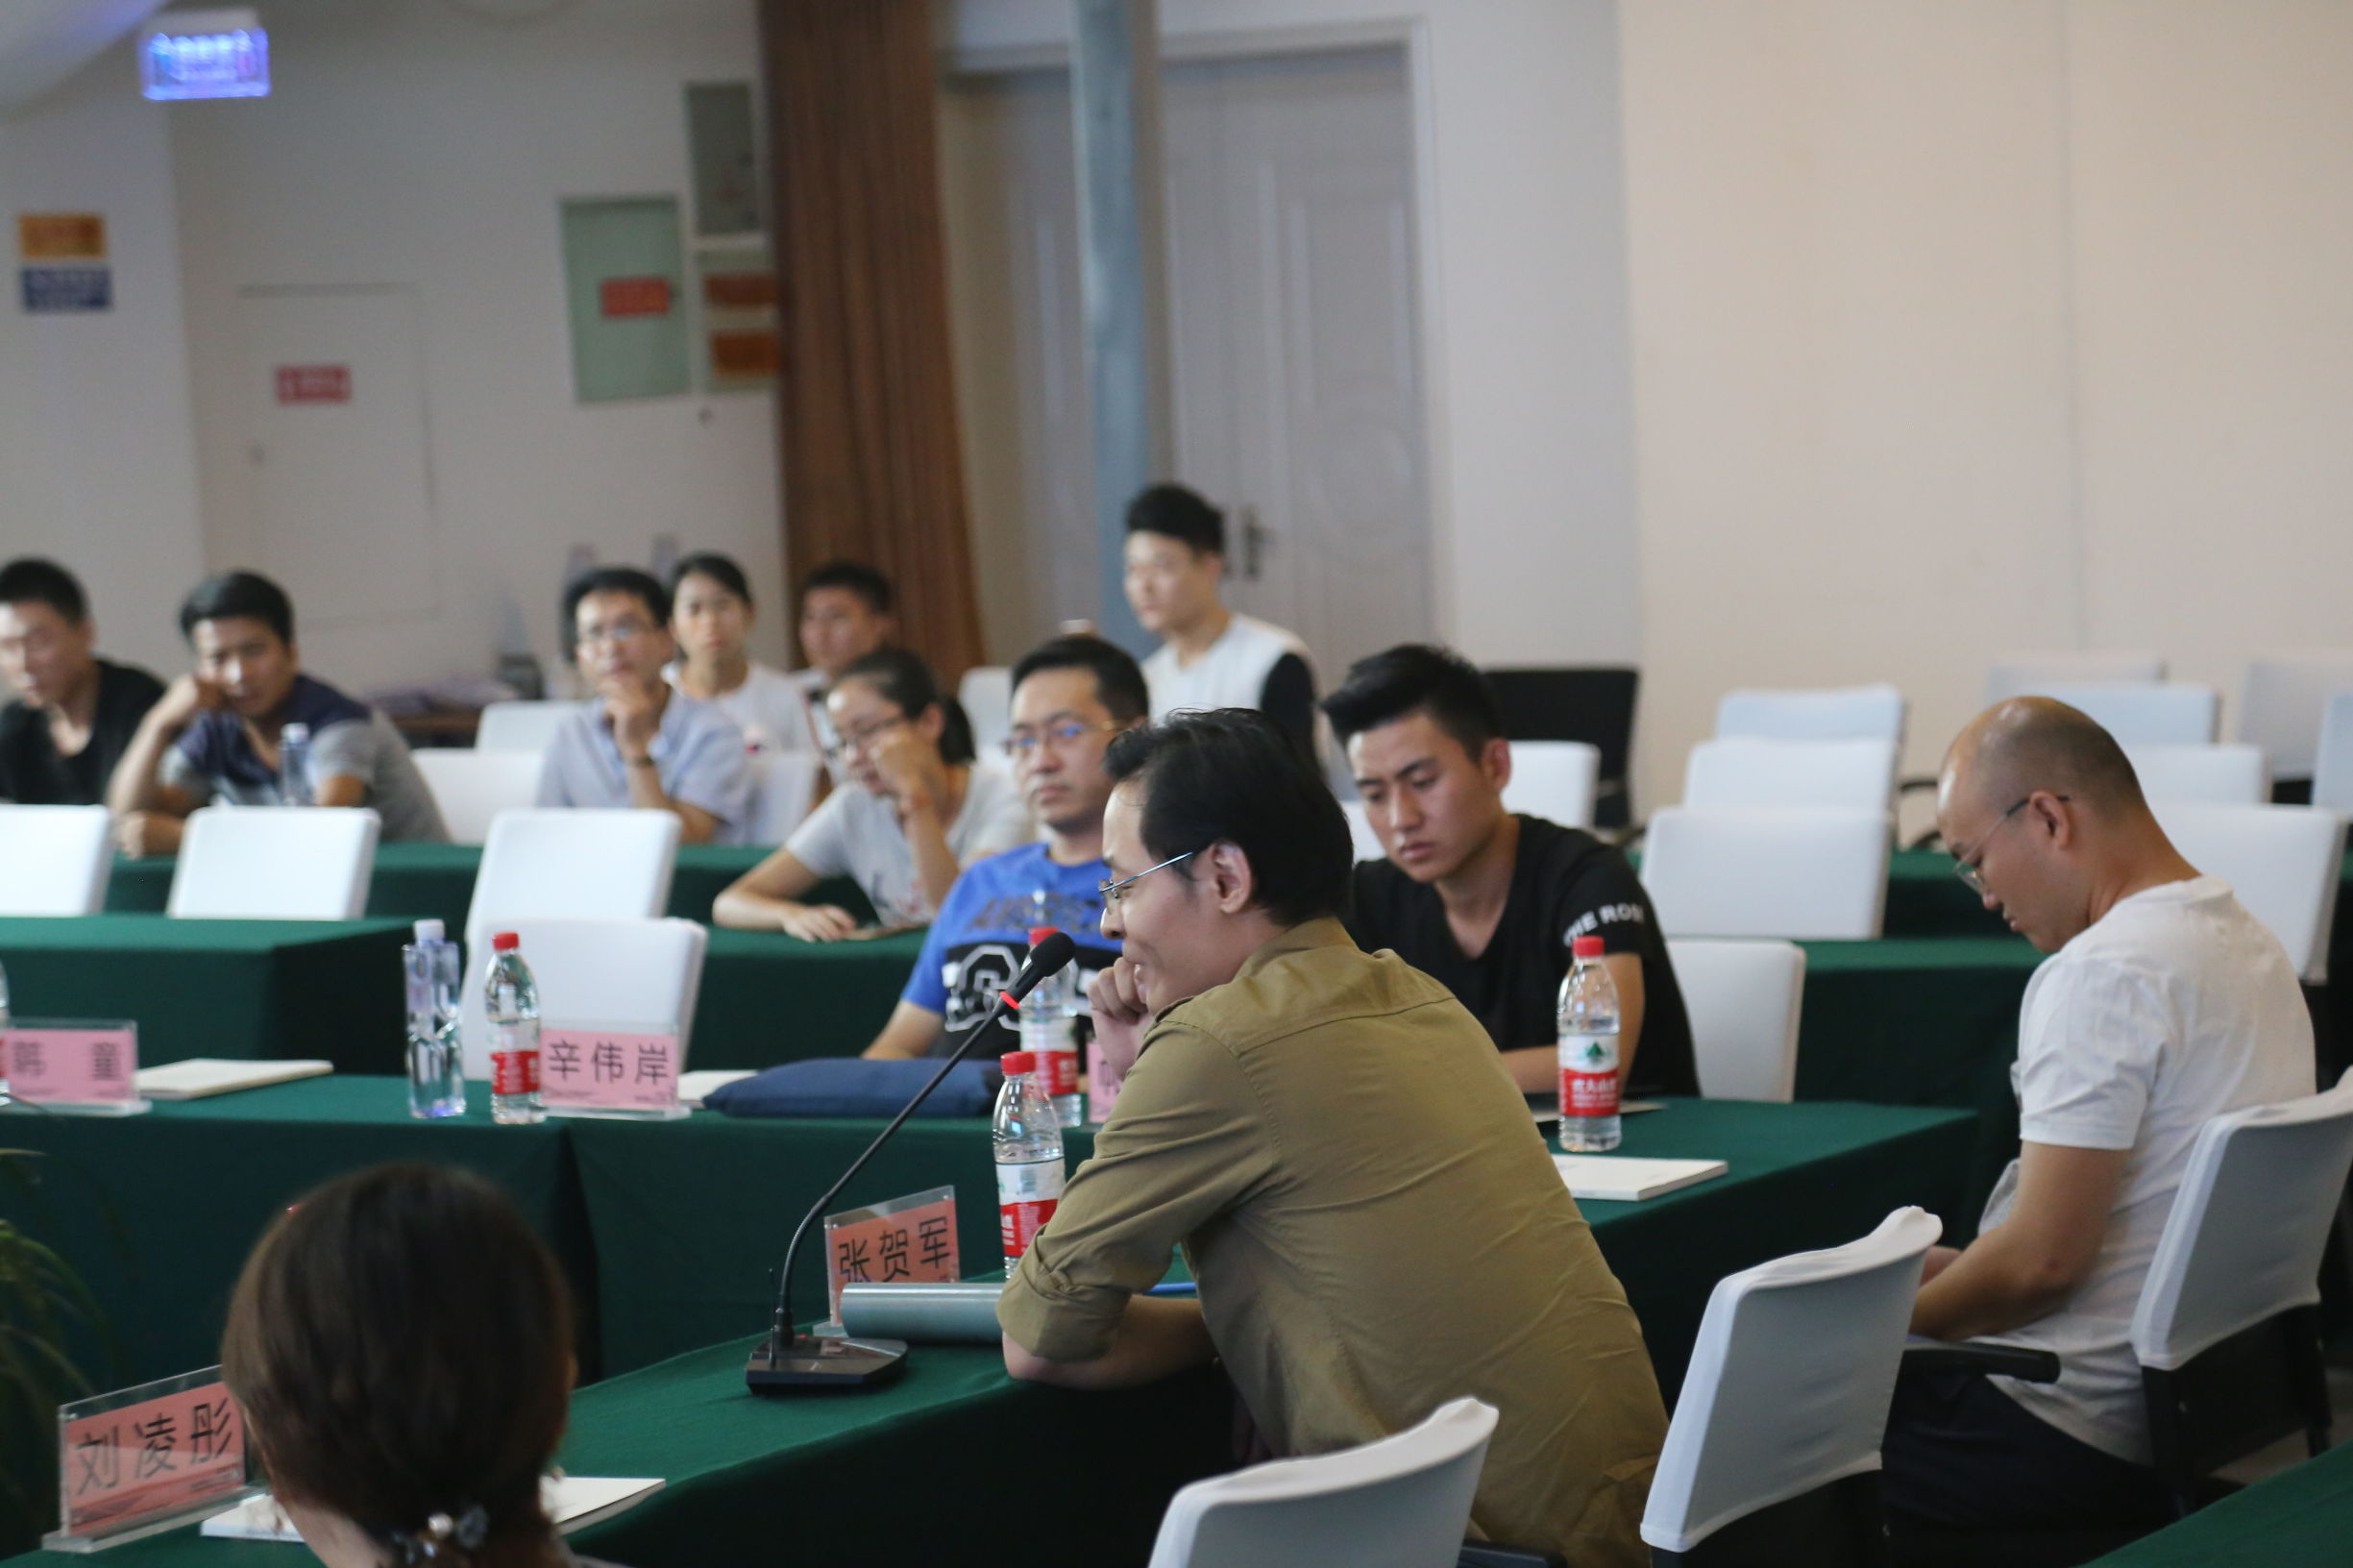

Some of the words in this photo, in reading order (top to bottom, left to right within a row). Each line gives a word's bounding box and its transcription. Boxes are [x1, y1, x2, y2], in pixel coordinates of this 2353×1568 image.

[548, 1039, 669, 1085] 辛伟岸
[838, 1215, 950, 1283] 张贺军
[76, 1397, 233, 1495] 刘凌彤
